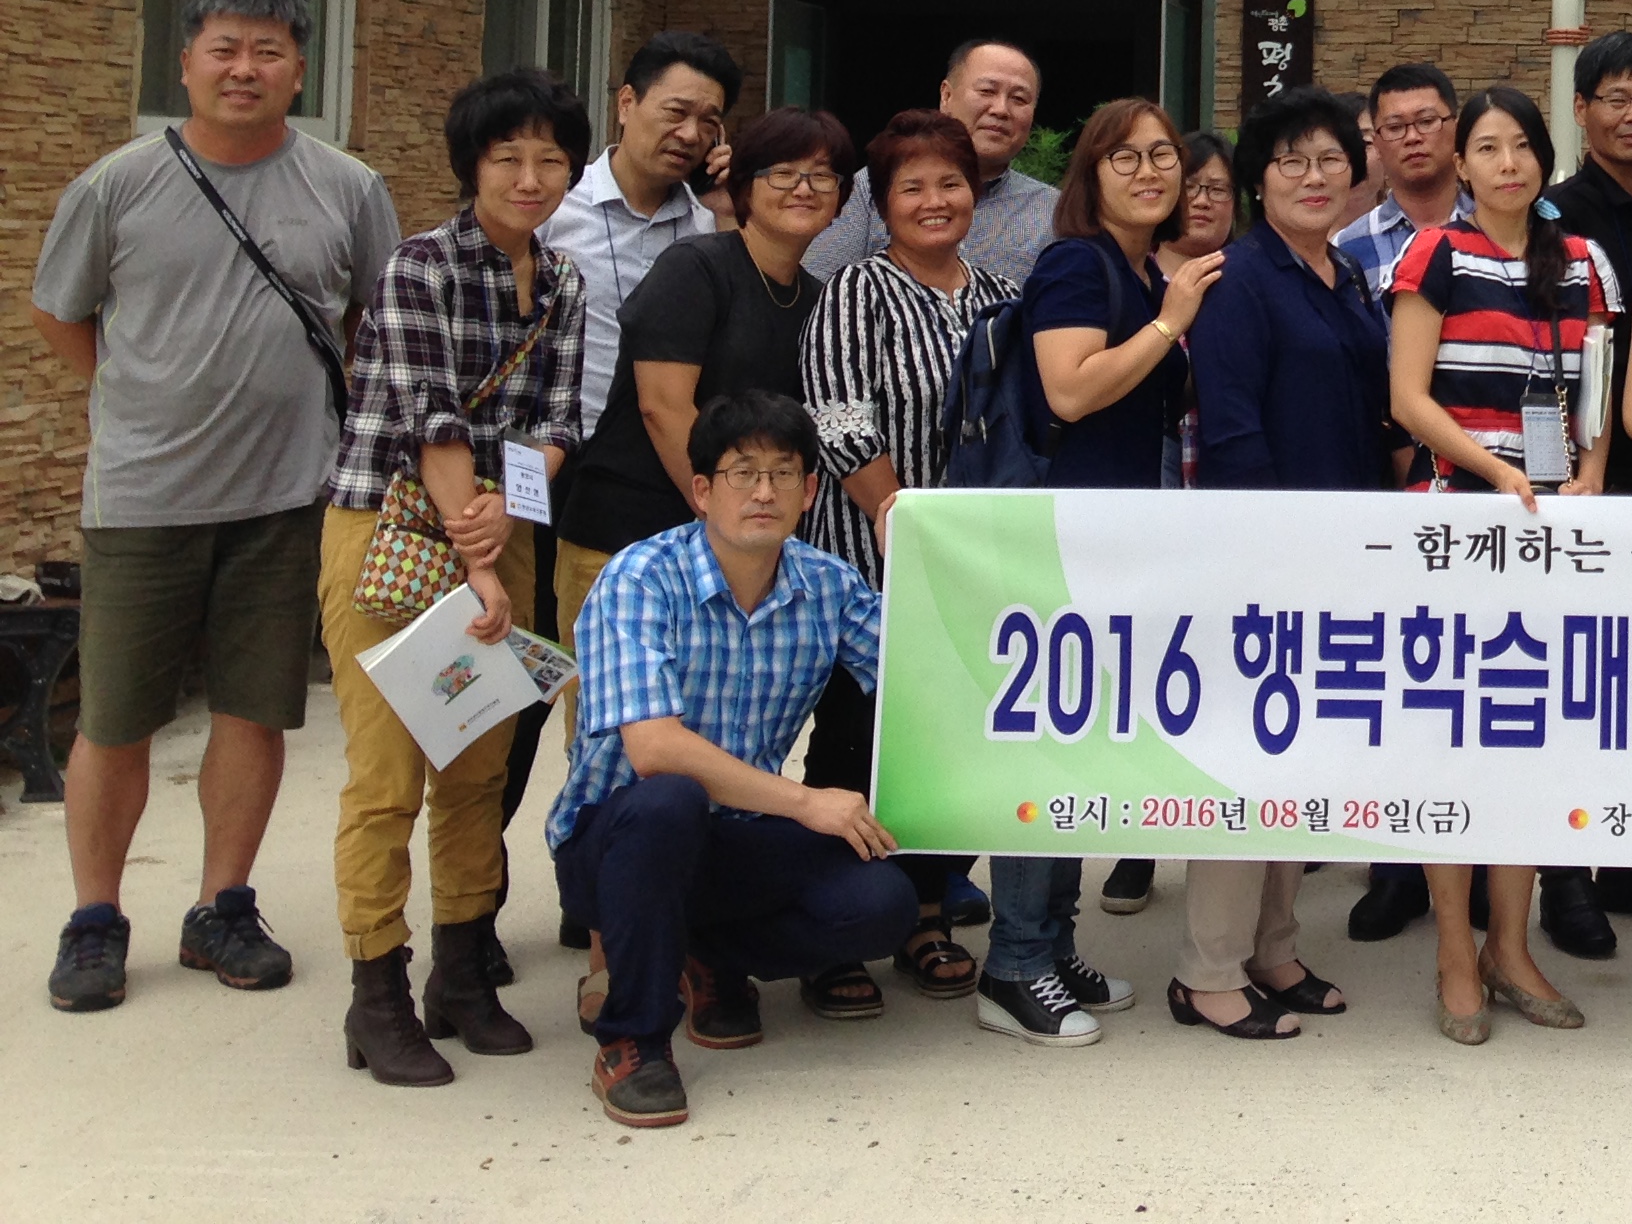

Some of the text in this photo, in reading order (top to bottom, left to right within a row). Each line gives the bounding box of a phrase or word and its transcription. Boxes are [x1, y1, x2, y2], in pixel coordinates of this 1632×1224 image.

[1413, 523, 1612, 575] 함께하는
[992, 610, 1202, 737] 2016
[1140, 796, 1248, 832] 2016년
[1259, 797, 1331, 833] 08월
[1342, 799, 1472, 836] 26일(금)
